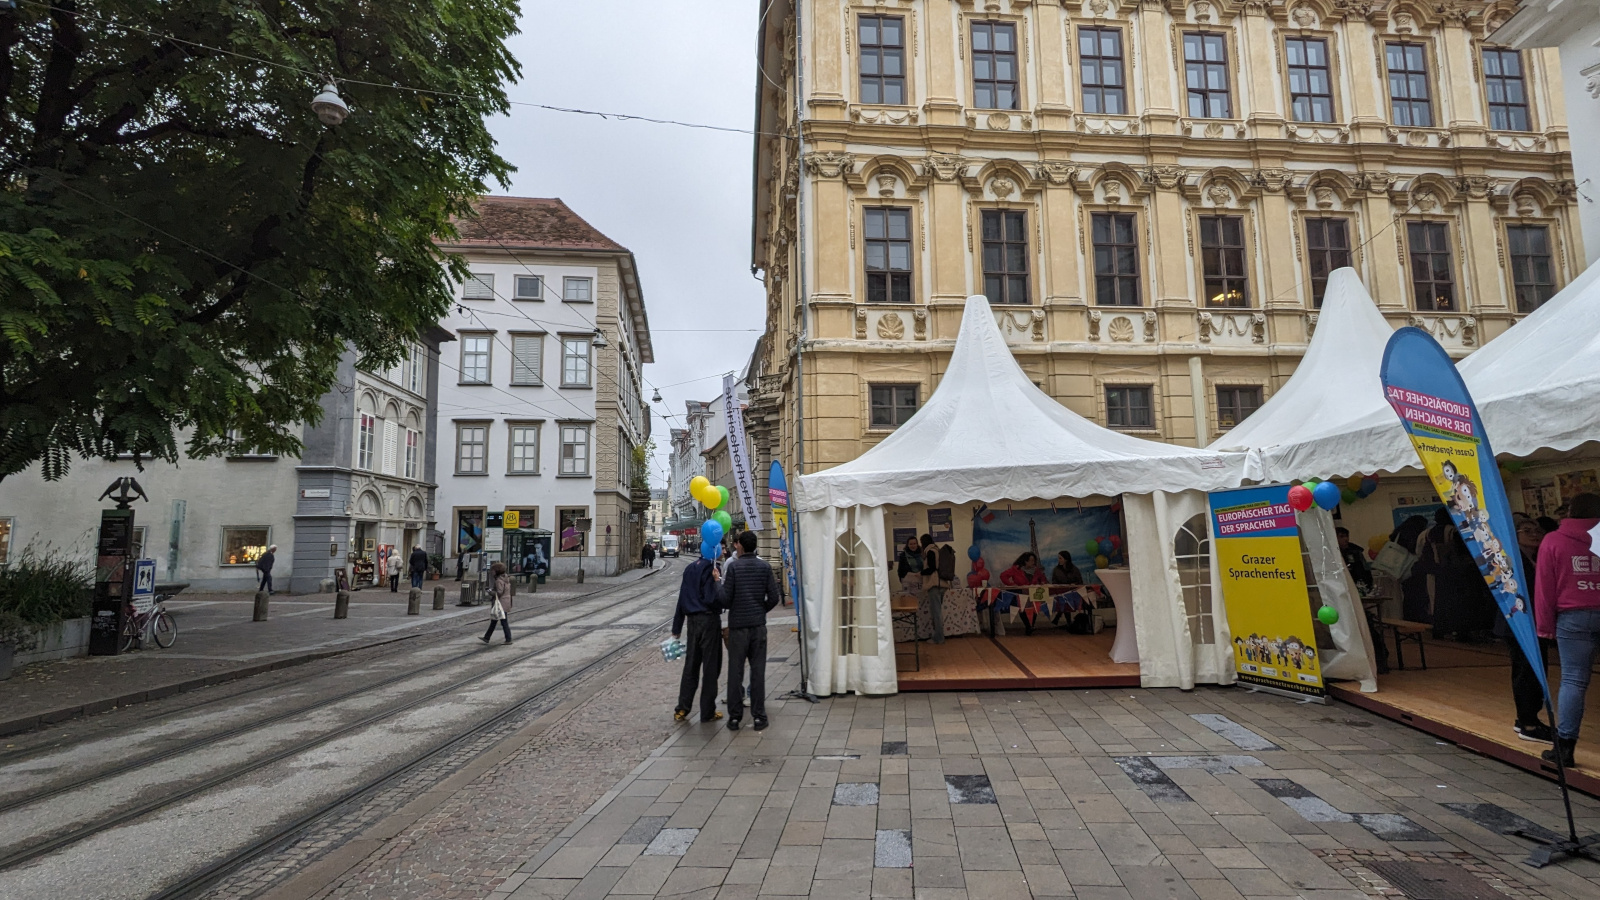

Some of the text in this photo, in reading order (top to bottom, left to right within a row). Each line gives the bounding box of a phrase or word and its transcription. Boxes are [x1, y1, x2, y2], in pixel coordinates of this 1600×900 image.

[1218, 506, 1274, 523] EUROPÄISCHER
[1273, 504, 1291, 515] TAG
[1220, 519, 1276, 534] DER SPRACHEN
[1241, 554, 1276, 565] Grazer
[1228, 567, 1297, 581] Sprachenfest
